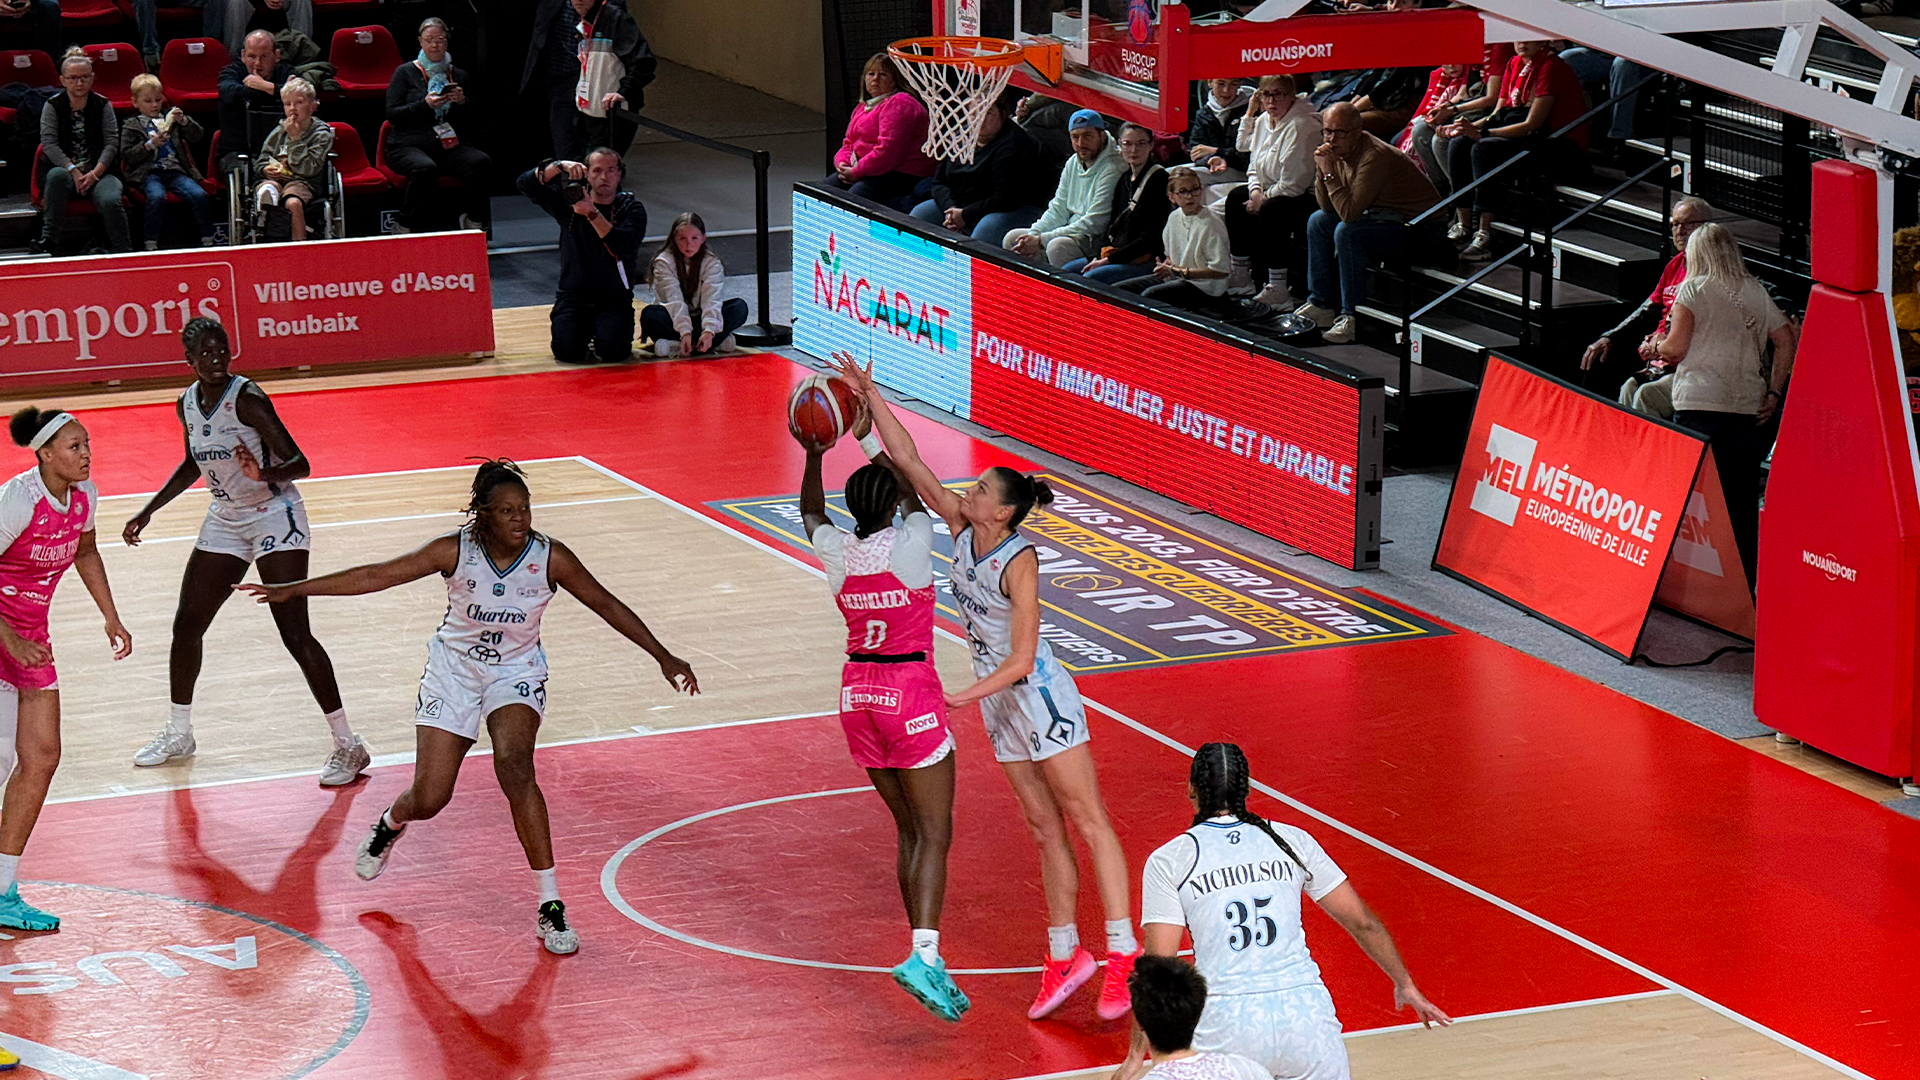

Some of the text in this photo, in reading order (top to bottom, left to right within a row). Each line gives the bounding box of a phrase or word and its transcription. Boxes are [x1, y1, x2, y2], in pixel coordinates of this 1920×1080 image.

[1121, 48, 1156, 69] EUROCUP
[1241, 43, 1333, 63] NOUANSPORT
[1123, 61, 1153, 80] WOMEN
[254, 272, 476, 303] Villeneuve d'Ascq
[814, 258, 950, 354] NACARAT
[258, 312, 360, 338] Roubaix
[974, 331, 1354, 496] POUR UN IMMOBILIER JUSTE ET DURABLE
[192, 446, 232, 461] hartres
[1533, 462, 1662, 543] MÉTROPOLE
[1525, 498, 1649, 567] EUROPÉENNE DE LILLE
[1051, 490, 1391, 634] PUIS 2013, FIER D'ÊTRE
[1802, 550, 1857, 582] NOUANSPORT
[1094, 549, 1162, 572] DES
[1147, 573, 1327, 641] GUERRIÈRES
[467, 603, 527, 623] Chartres
[1040, 619, 1127, 663] NTIERS
[1147, 614, 1258, 646] TP
[907, 714, 936, 731] Nord
[1188, 860, 1295, 900] NICHOLSON
[1225, 894, 1278, 952] 35
